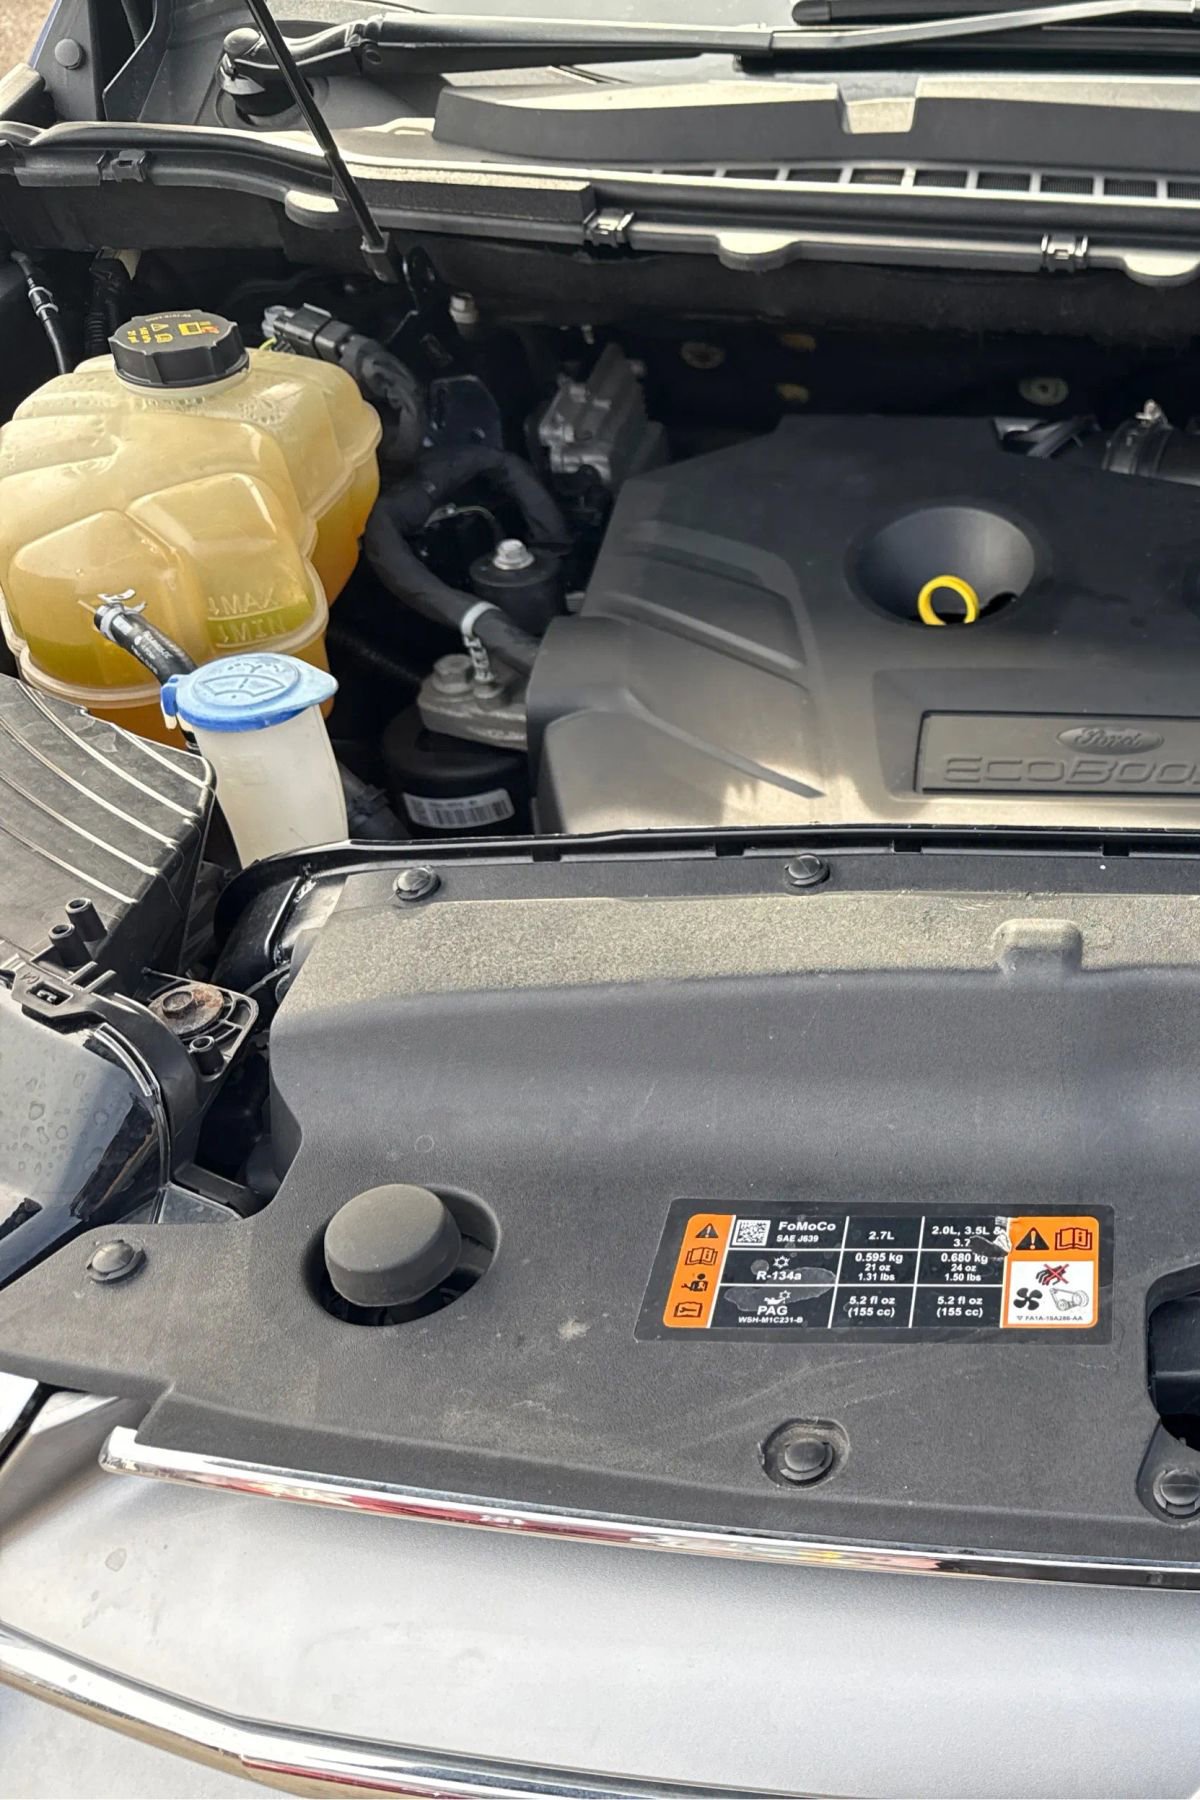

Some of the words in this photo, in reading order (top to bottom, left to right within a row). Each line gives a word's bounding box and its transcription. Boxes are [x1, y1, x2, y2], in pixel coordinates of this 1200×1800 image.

[778, 1221, 836, 1231] FoMoCo
[931, 1226, 961, 1235] 2.0L,
[964, 1226, 990, 1235] 3.5L
[776, 1234, 796, 1243] SAE
[868, 1231, 895, 1240] 2.7L
[855, 1253, 887, 1262] 0.595
[889, 1253, 903, 1264] kg
[941, 1253, 972, 1262] 0.680
[974, 1253, 988, 1264] kg
[951, 1264, 963, 1272] 24
[756, 1271, 802, 1280] R-134a
[857, 1273, 877, 1281] 1.31
[880, 1273, 895, 1281] lbs
[945, 1273, 964, 1281] 1.50
[849, 1296, 867, 1305] 5.2
[869, 1296, 877, 1305] fl
[880, 1297, 896, 1305] oz
[937, 1296, 955, 1305] 5.2
[957, 1296, 965, 1305] fl
[968, 1297, 983, 1305] oz
[757, 1305, 788, 1315] PAG
[848, 1307, 874, 1317] (155
[876, 1307, 896, 1317] cc)
[936, 1308, 962, 1318] (155
[964, 1308, 983, 1318] cc)
